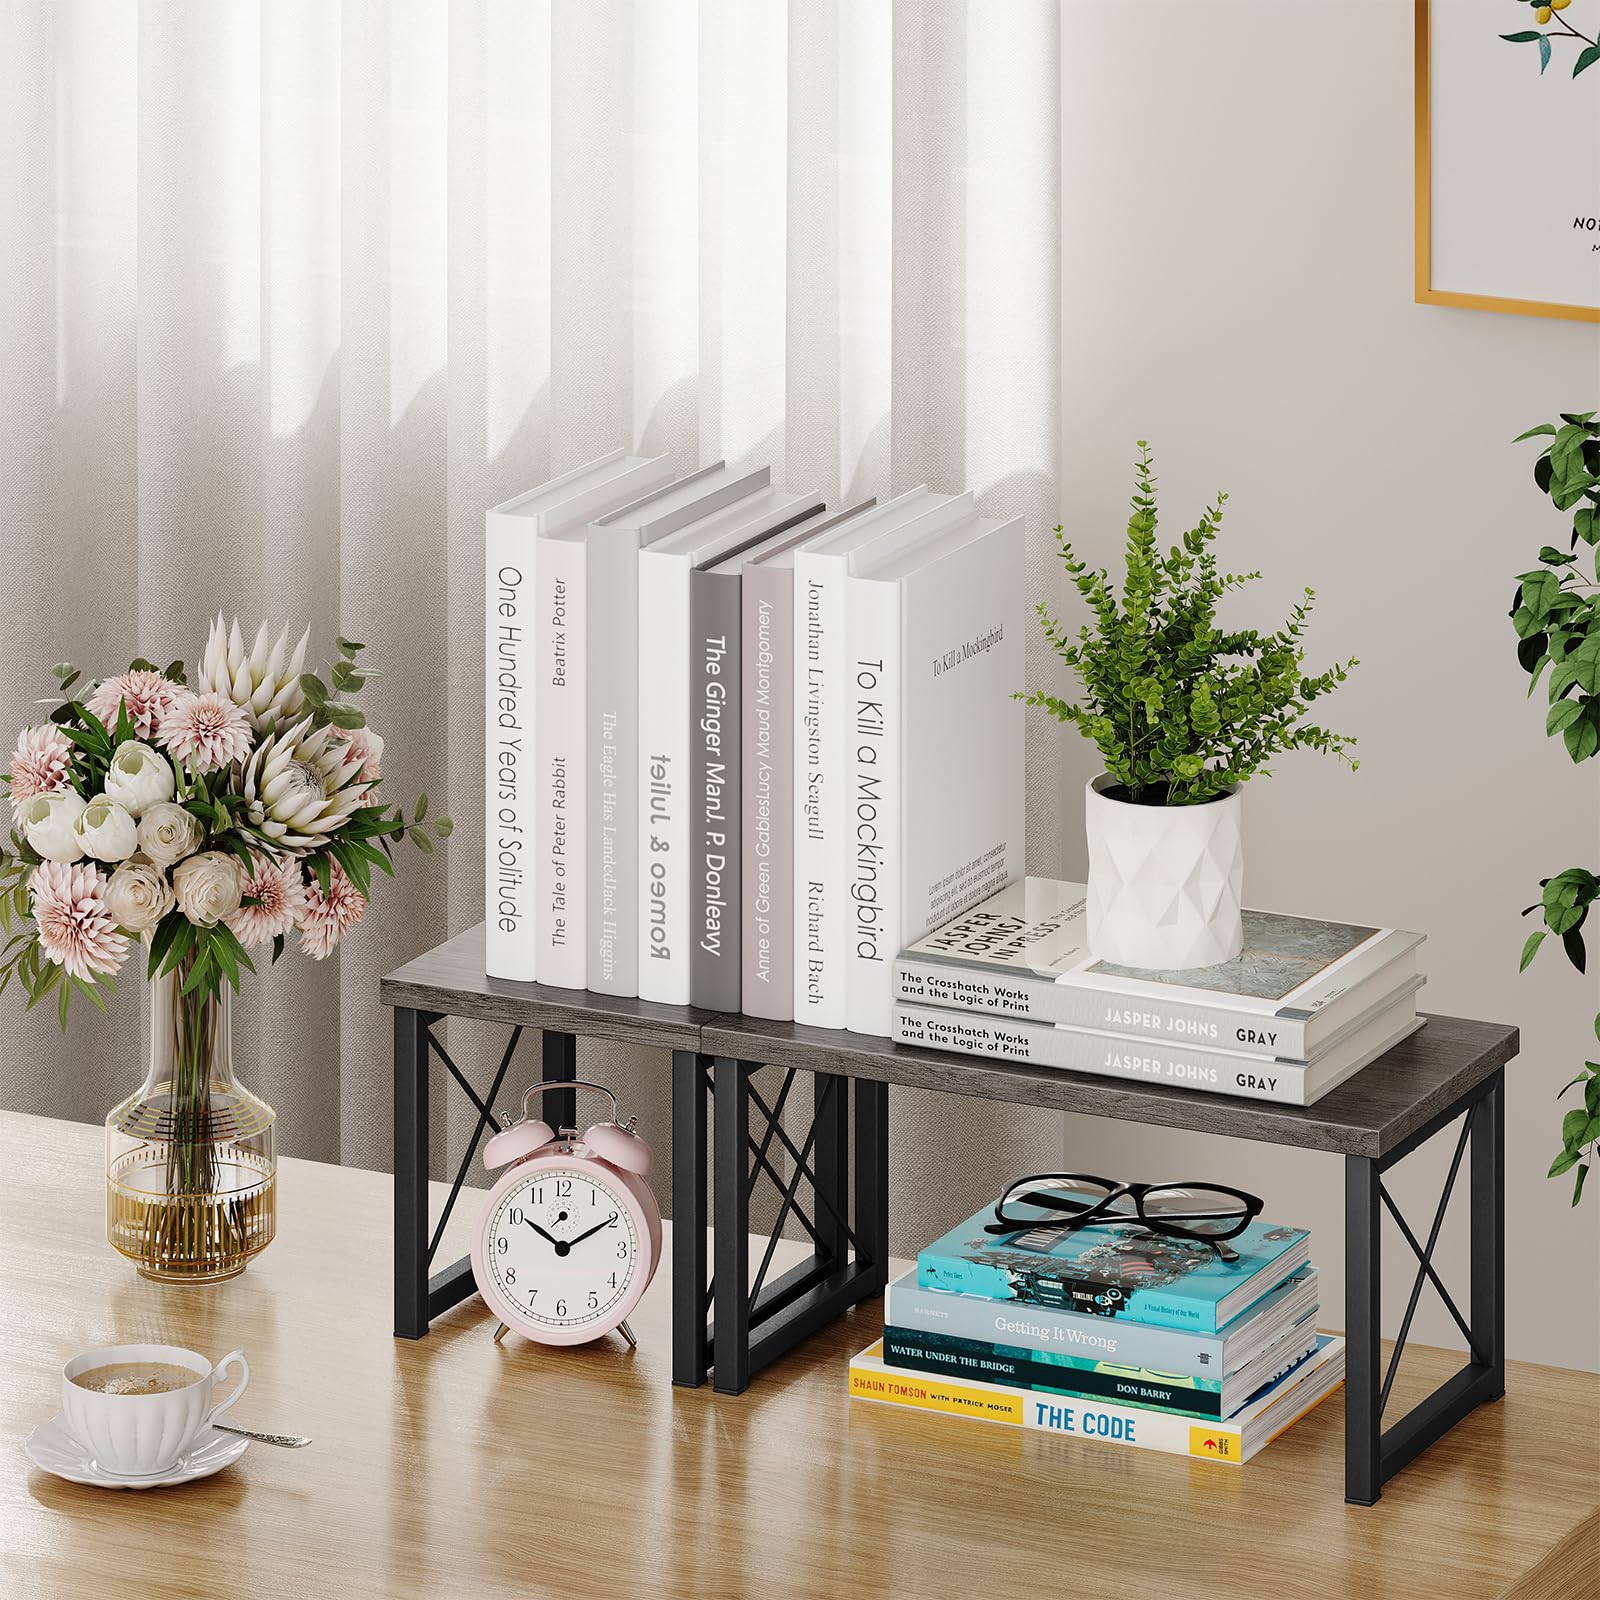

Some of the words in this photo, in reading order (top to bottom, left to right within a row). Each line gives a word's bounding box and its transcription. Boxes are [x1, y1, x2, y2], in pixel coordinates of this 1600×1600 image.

[498, 566, 523, 618] One
[552, 577, 566, 627] Potter
[808, 579, 825, 661] Jonathan
[552, 631, 566, 687] Beatrix
[705, 635, 727, 676] The
[756, 599, 774, 705] Montgomery
[933, 660, 941, 677] To
[943, 650, 955, 672] Kill
[957, 651, 961, 664] a
[962, 623, 1003, 661] Mockingbird
[498, 625, 523, 730] Hundred
[857, 659, 883, 690] To
[603, 711, 617, 740] The
[701, 681, 727, 757] Ginger
[803, 668, 825, 765] Livingston
[857, 700, 884, 737] Kill
[756, 708, 770, 759] Maud
[498, 738, 523, 801] Years
[599, 743, 617, 788] Eagle
[857, 745, 877, 765] a
[552, 756, 566, 809] Rabbit
[498, 808, 524, 834] of
[603, 792, 617, 822] Has
[803, 772, 825, 840] Seagull
[552, 813, 566, 856] Peter
[706, 831, 726, 846] P.
[552, 859, 566, 877] of
[850, 774, 884, 962] Mockingbird
[498, 837, 524, 933] Solitude
[552, 882, 566, 913] Tale
[756, 862, 770, 913] Green
[700, 853, 727, 957] Donleavy
[808, 881, 825, 953] Richard
[552, 918, 566, 947] The
[756, 916, 770, 934] of
[925, 912, 1001, 950] JASPER
[599, 921, 617, 980] Higgins
[988, 948, 1019, 961] IN
[1007, 922, 1061, 949] PRESS
[756, 938, 770, 983] Anne
[808, 959, 825, 1004] Bach
[900, 972, 922, 984] The
[926, 976, 989, 995] Crosshatch
[994, 986, 1030, 1001] Works
[902, 984, 924, 995] and
[929, 988, 948, 999] the
[953, 991, 983, 1007] Logic
[987, 996, 999, 1007] of
[1002, 1000, 1030, 1012] Print
[900, 1016, 922, 1028] The
[926, 1020, 989, 1039] Crosshatch
[994, 1031, 1030, 1045] Works
[1104, 1007, 1161, 1030] JASPER
[1166, 1017, 1218, 1038] JOHNS
[1236, 1028, 1277, 1046] GRAY
[902, 1028, 924, 1039] and
[929, 1032, 948, 1043] the
[953, 1035, 983, 1051] Logic
[987, 1040, 999, 1051] of
[1002, 1044, 1030, 1057] Print
[1104, 1052, 1161, 1075] JASPER
[1166, 1062, 1218, 1083] JOHNS
[1236, 1073, 1277, 1091] GRAY
[531, 1187, 544, 1204] 11
[556, 1180, 572, 1197] 12
[591, 1189, 596, 1206] 1
[509, 1207, 524, 1225] 10
[608, 1210, 618, 1229] 2
[498, 1237, 508, 1254] 9
[617, 1241, 627, 1259] 3
[505, 1267, 516, 1285] 8
[607, 1272, 617, 1289] 4
[528, 1289, 538, 1307] 7
[556, 1299, 567, 1317] 6
[587, 1291, 598, 1309] 5
[995, 1317, 1050, 1342] Getting
[1052, 1326, 1065, 1341] It
[1066, 1328, 1117, 1352] Wrong
[890, 1344, 923, 1358] WATER
[925, 1349, 957, 1363] UNDER
[959, 1355, 979, 1368] THE
[980, 1359, 1016, 1374] BRIDGE
[853, 1377, 885, 1393] SHAUN
[888, 1383, 927, 1399] TOMSON
[952, 1397, 984, 1408] PATRICK
[987, 1403, 1013, 1413] MOSER
[1117, 1383, 1138, 1395] DON
[1140, 1386, 1172, 1401] BARRY
[1036, 1402, 1075, 1432] THE
[1082, 1411, 1136, 1442] CODE
